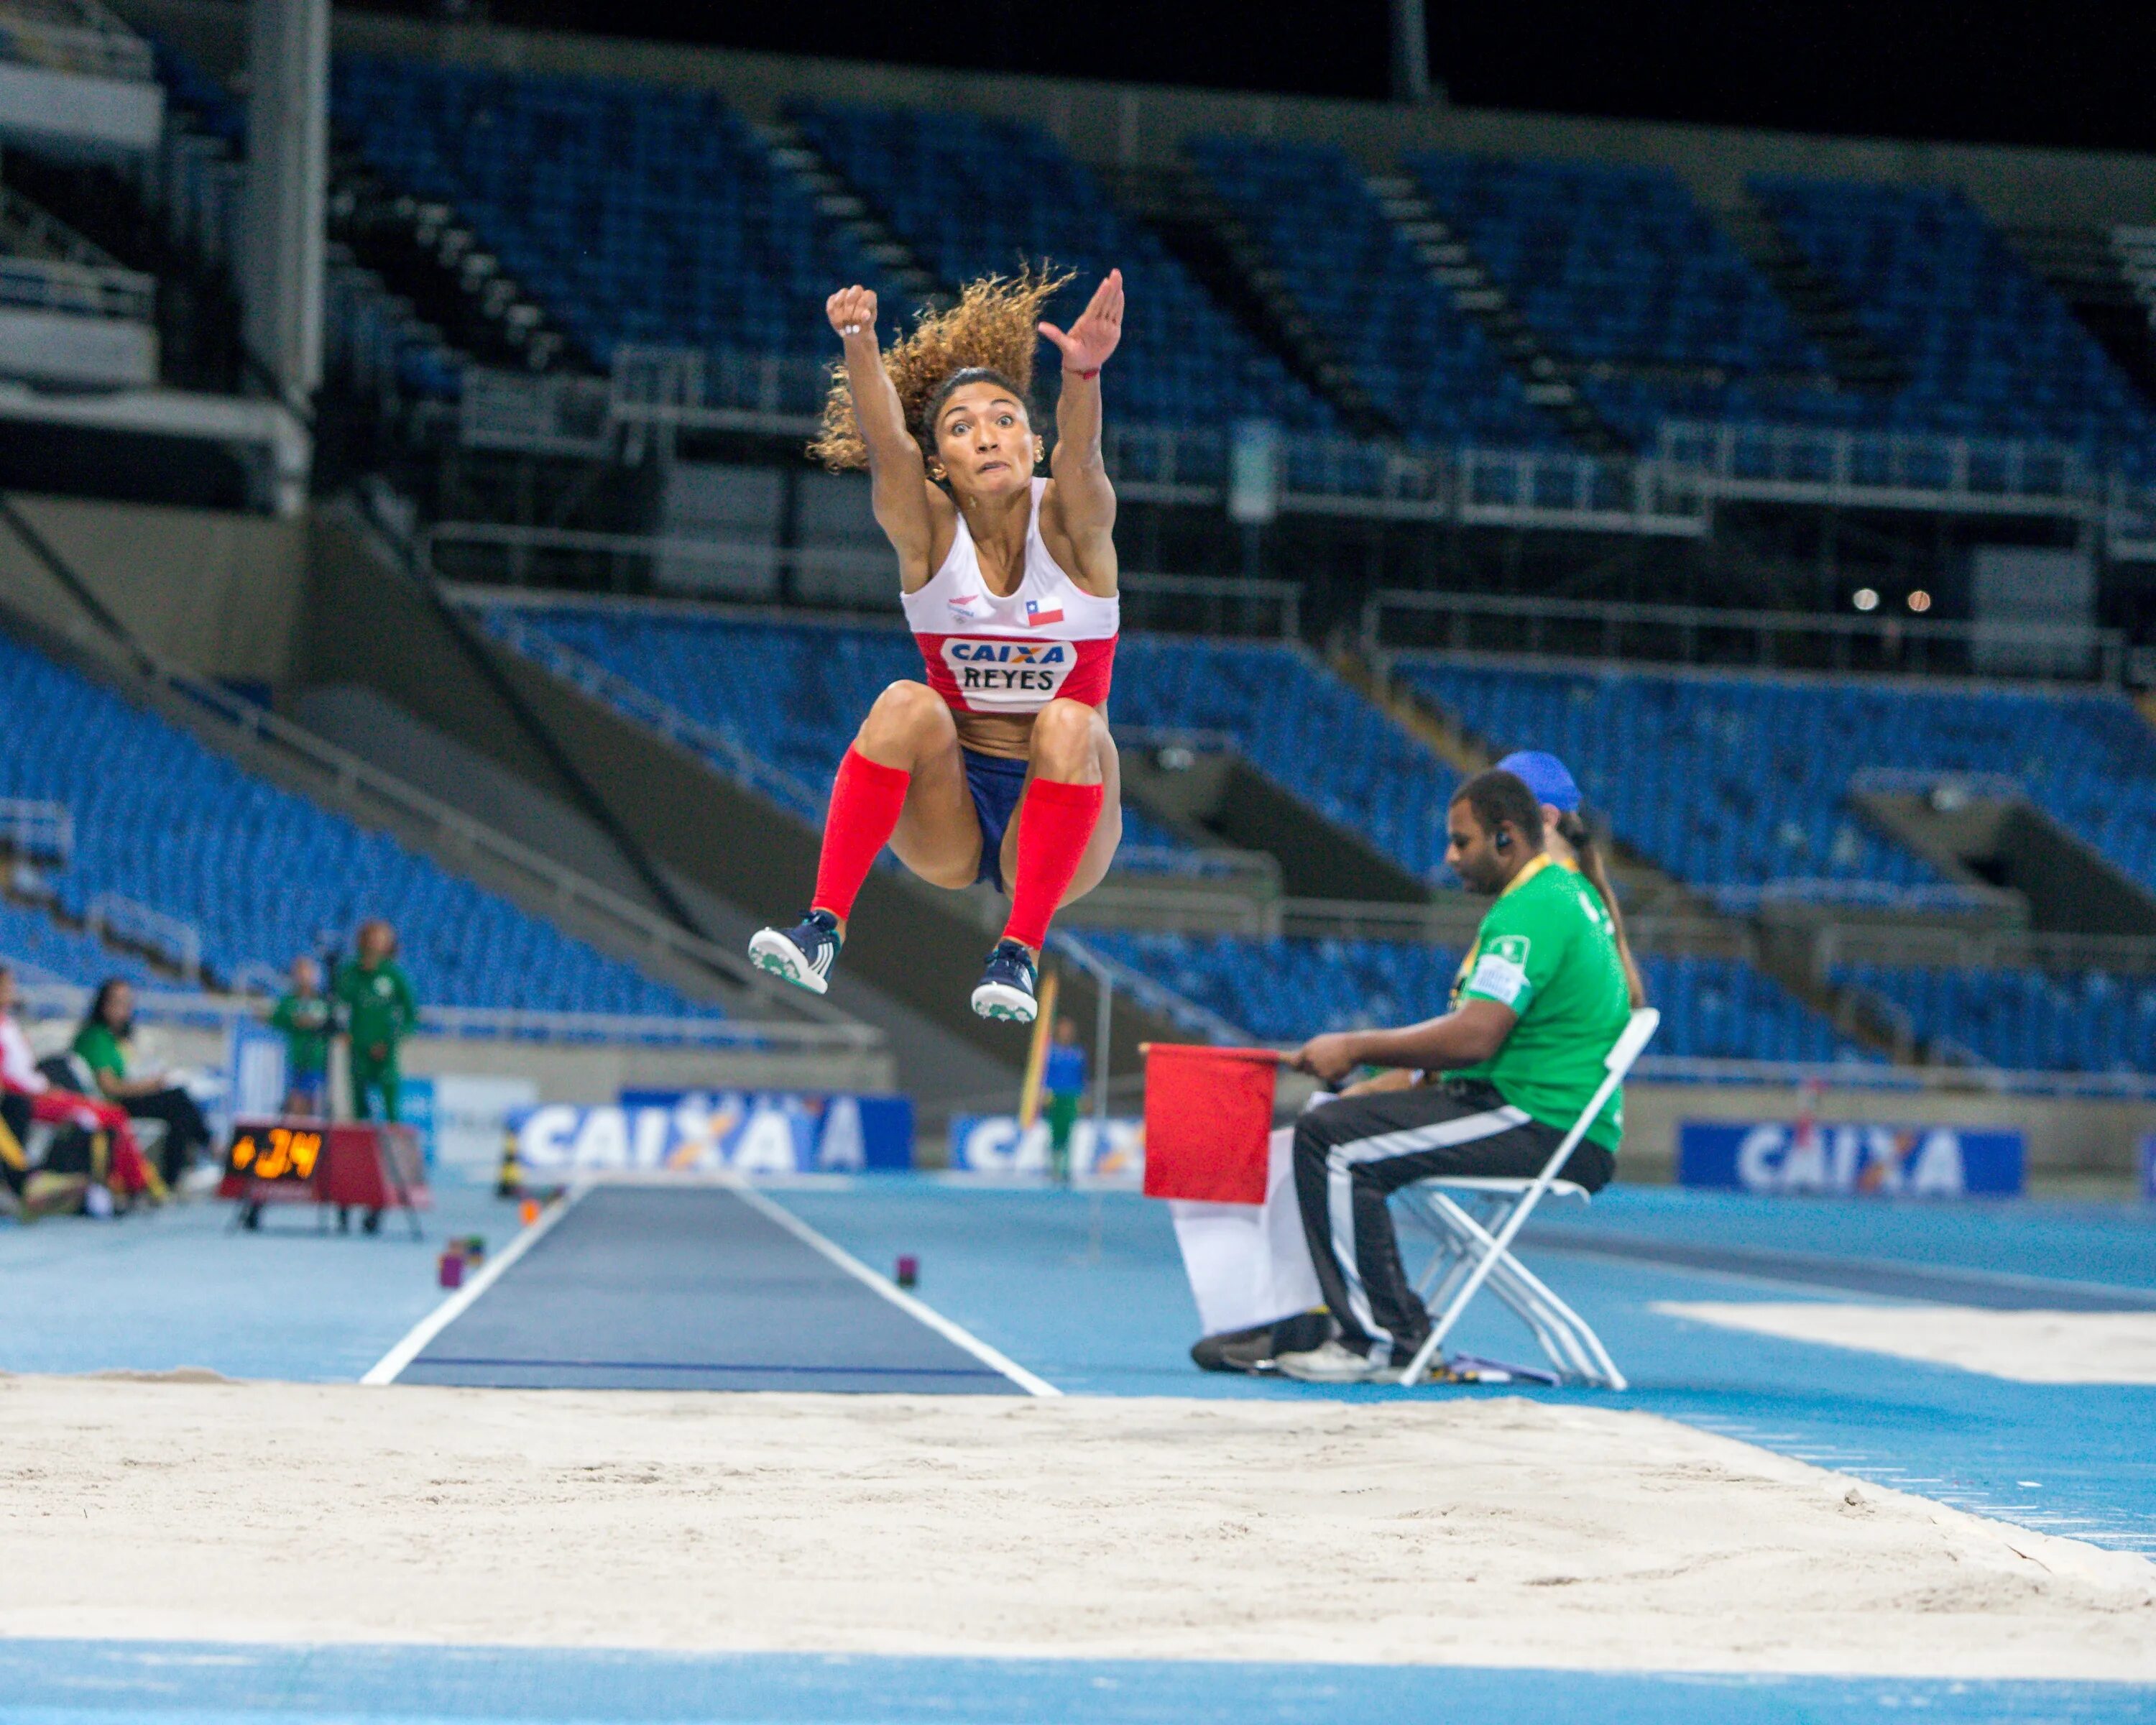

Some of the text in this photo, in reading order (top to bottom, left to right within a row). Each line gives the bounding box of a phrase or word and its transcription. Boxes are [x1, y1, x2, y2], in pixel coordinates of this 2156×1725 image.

[952, 644, 1064, 663] CAIXA
[964, 666, 1055, 690] REYES
[520, 1105, 796, 1170] CAIXA
[967, 1116, 1146, 1173] CAIX
[1738, 1123, 1964, 1193] CAIXA
